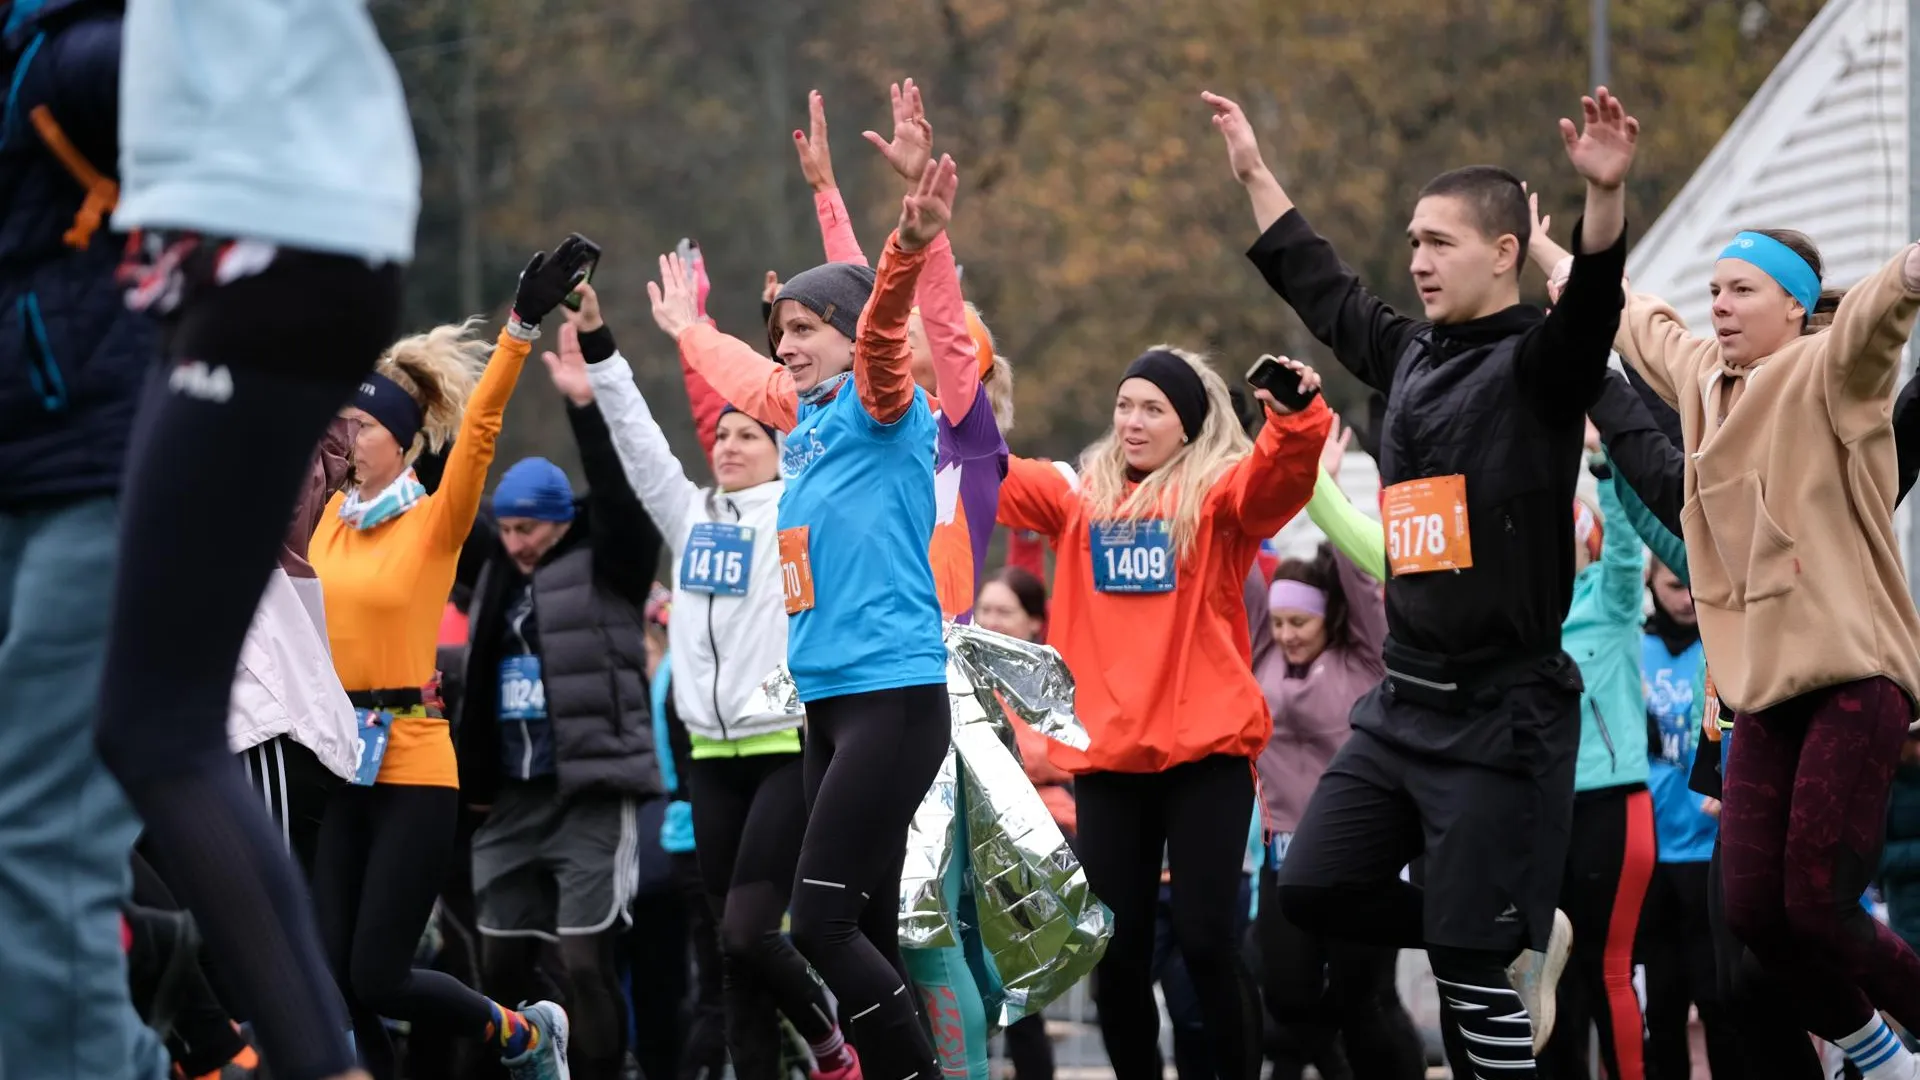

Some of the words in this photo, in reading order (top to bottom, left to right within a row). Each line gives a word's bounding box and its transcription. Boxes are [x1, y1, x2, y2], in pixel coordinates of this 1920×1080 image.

[1389, 513, 1447, 560] 5178
[688, 548, 743, 585] 1415
[781, 560, 802, 599] 70
[1104, 546, 1166, 580] 1409
